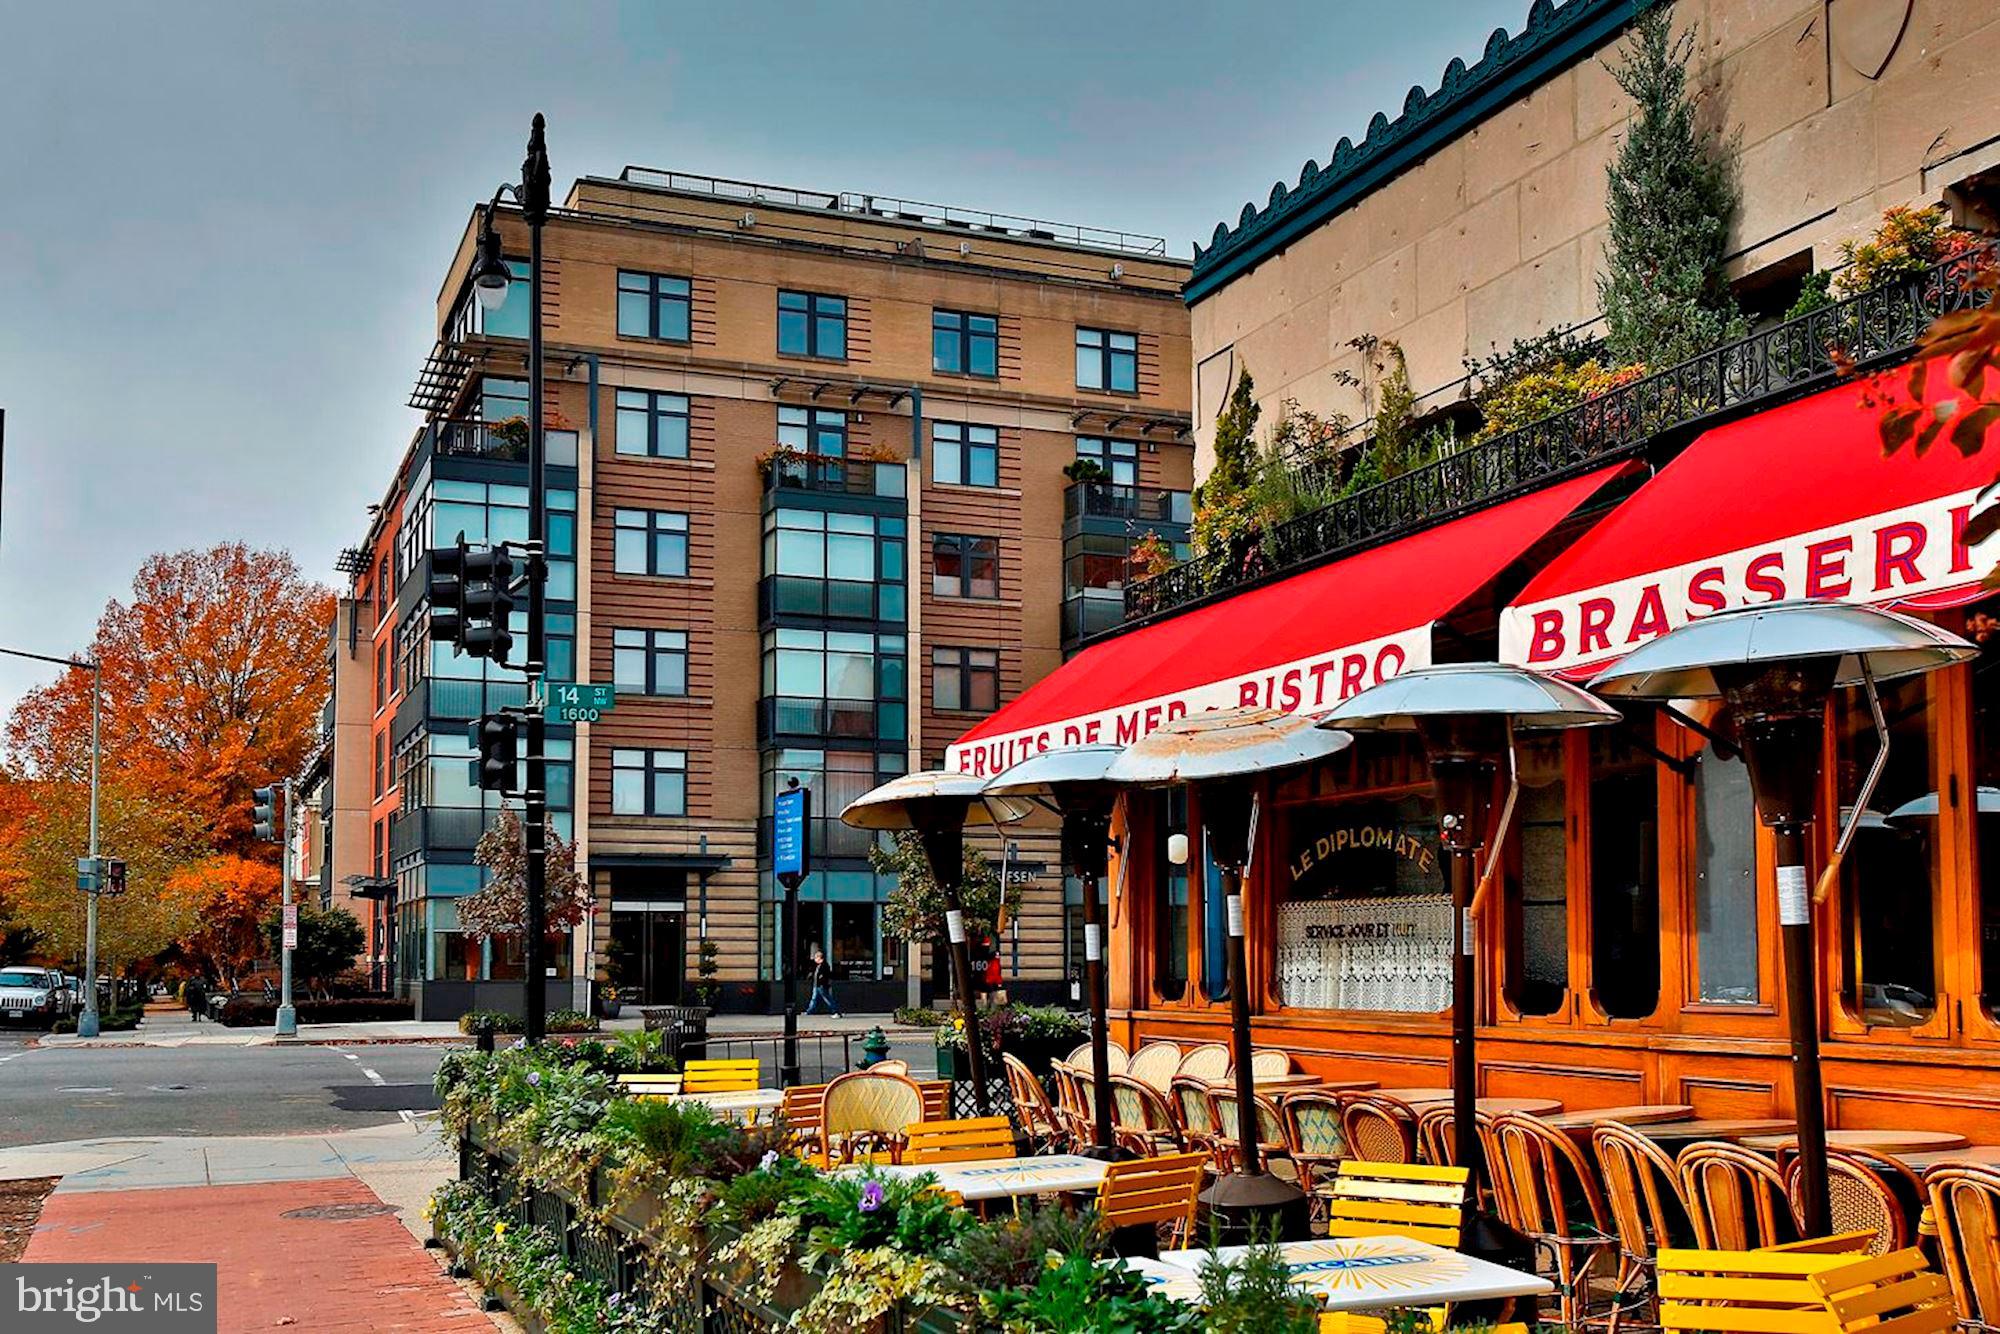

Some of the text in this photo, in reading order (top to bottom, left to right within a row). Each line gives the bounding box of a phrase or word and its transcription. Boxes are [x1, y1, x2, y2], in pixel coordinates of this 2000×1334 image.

[1528, 496, 2000, 663] BRASSERI
[558, 686, 607, 704] 14 ST
[959, 731, 1050, 777] FRUITS
[1064, 720, 1101, 746] DE
[1239, 643, 1406, 713] BISTRO
[561, 708, 599, 721] 1600
[1290, 825, 1434, 881] LE DIPLOMATE
[1306, 924, 1346, 939] SERVICE
